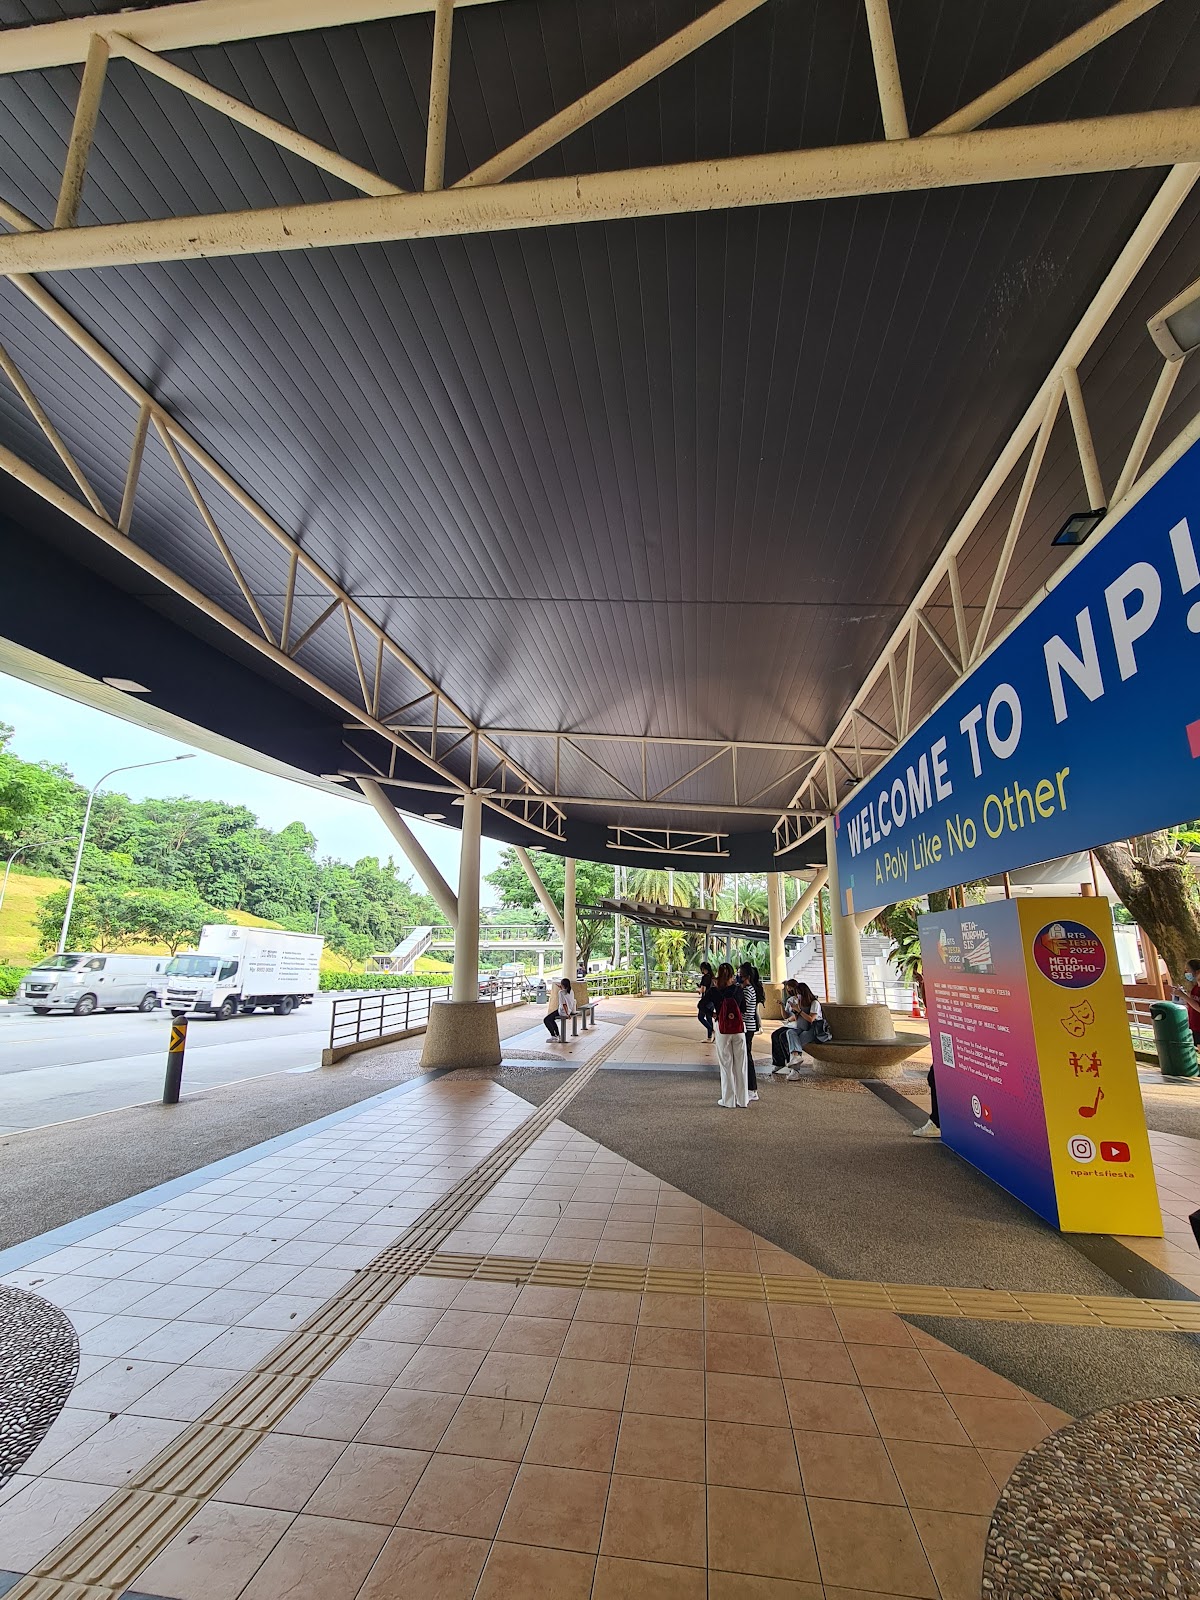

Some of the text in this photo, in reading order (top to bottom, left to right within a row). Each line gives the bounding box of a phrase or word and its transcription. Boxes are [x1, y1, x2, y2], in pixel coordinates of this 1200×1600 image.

[846, 516, 1200, 858] WELCOME TO NP!
[874, 766, 1070, 887] A Poly Like No Other
[963, 940, 975, 949] SIS
[949, 955, 961, 963] 2022
[1049, 957, 1083, 965] META-
[1050, 964, 1101, 972] MORPHO-
[1070, 1170, 1135, 1178] npartsfiesta
